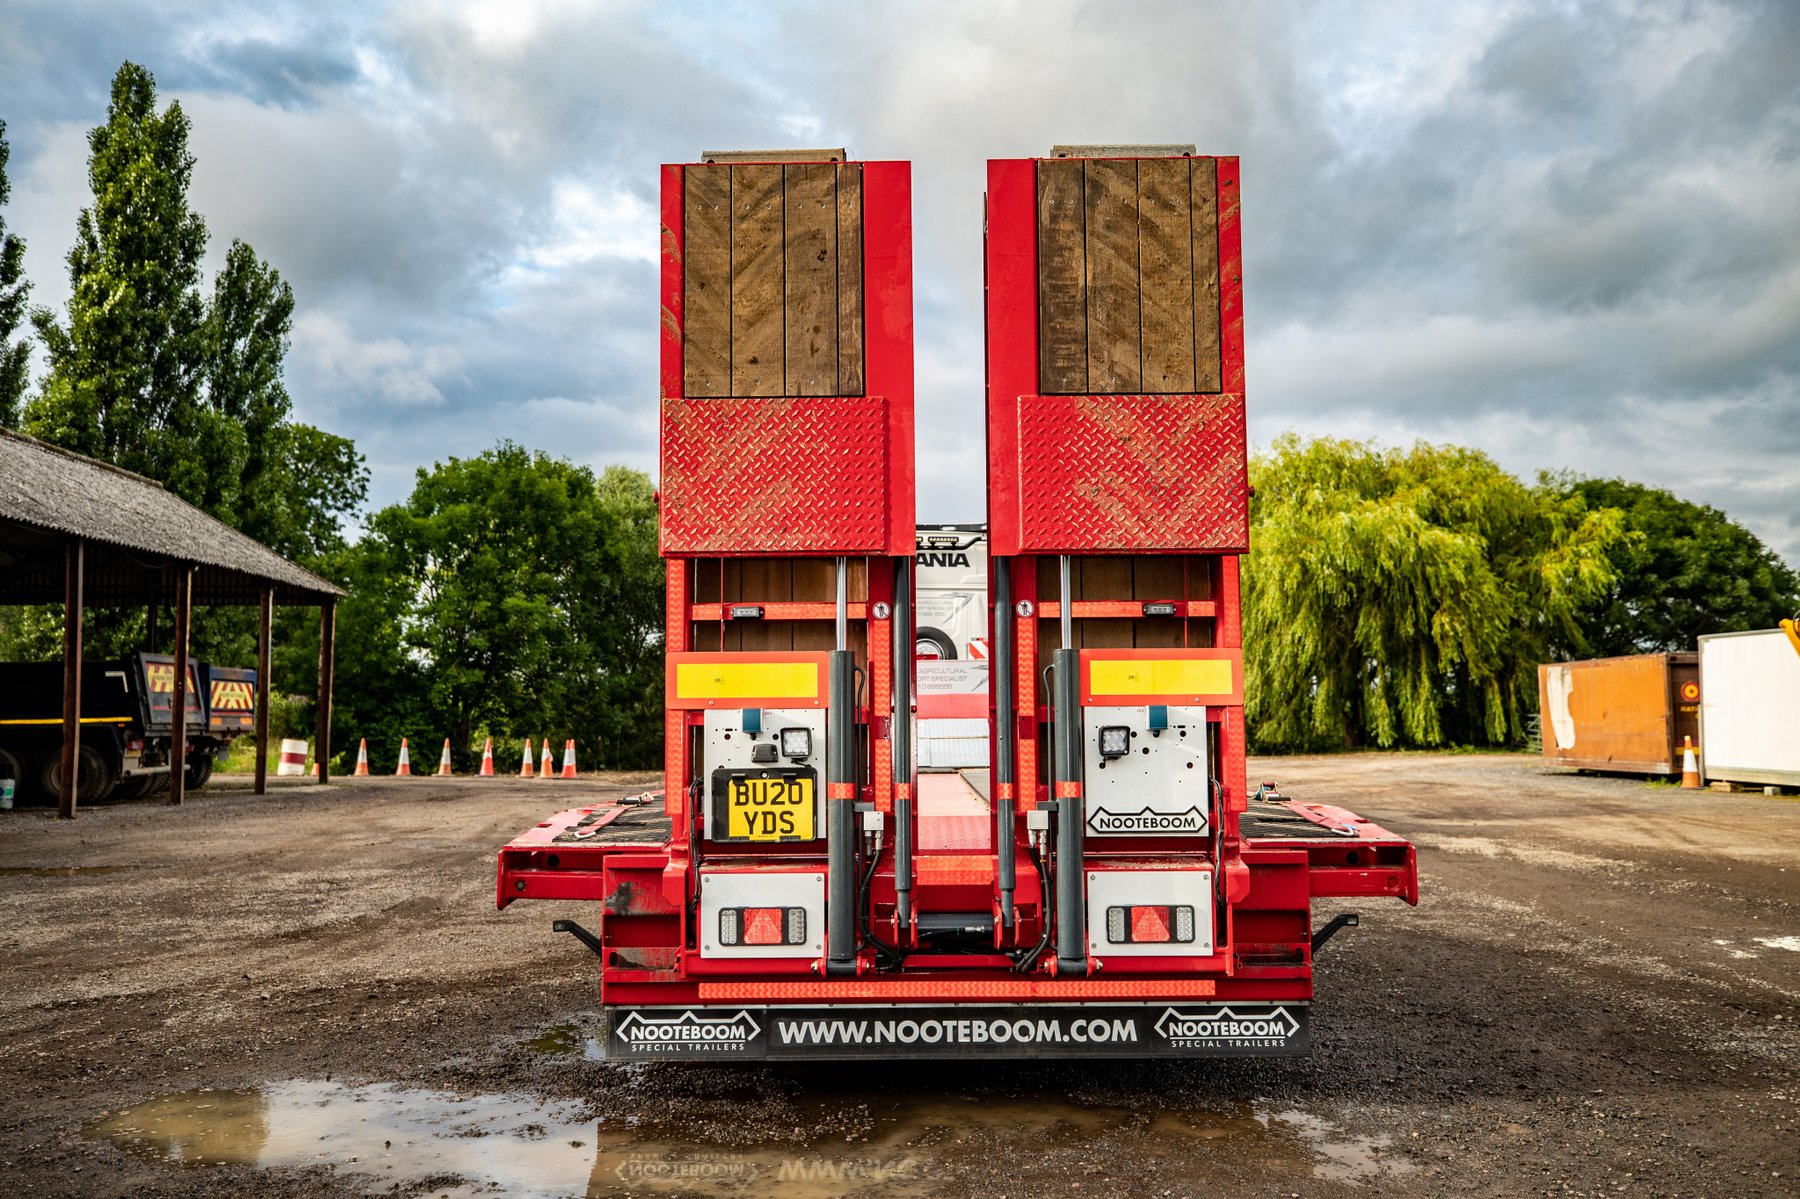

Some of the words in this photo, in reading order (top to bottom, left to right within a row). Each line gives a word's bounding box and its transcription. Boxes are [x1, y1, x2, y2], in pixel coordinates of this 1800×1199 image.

[734, 781, 803, 806] BU20
[743, 810, 795, 834] YDS
[1099, 817, 1196, 829] NOOTEBOOM
[631, 1025, 746, 1040] NOOTEBOOM
[778, 1019, 1138, 1044] WWW.NOOTEBOOM.COM
[1169, 1021, 1285, 1037] NOOTEBOOM
[632, 1043, 681, 1051] SPECIAL
[688, 1043, 745, 1051] TRAILERS
[1171, 1040, 1222, 1048] SPECIAL
[1228, 1040, 1285, 1048] TRAILERS
